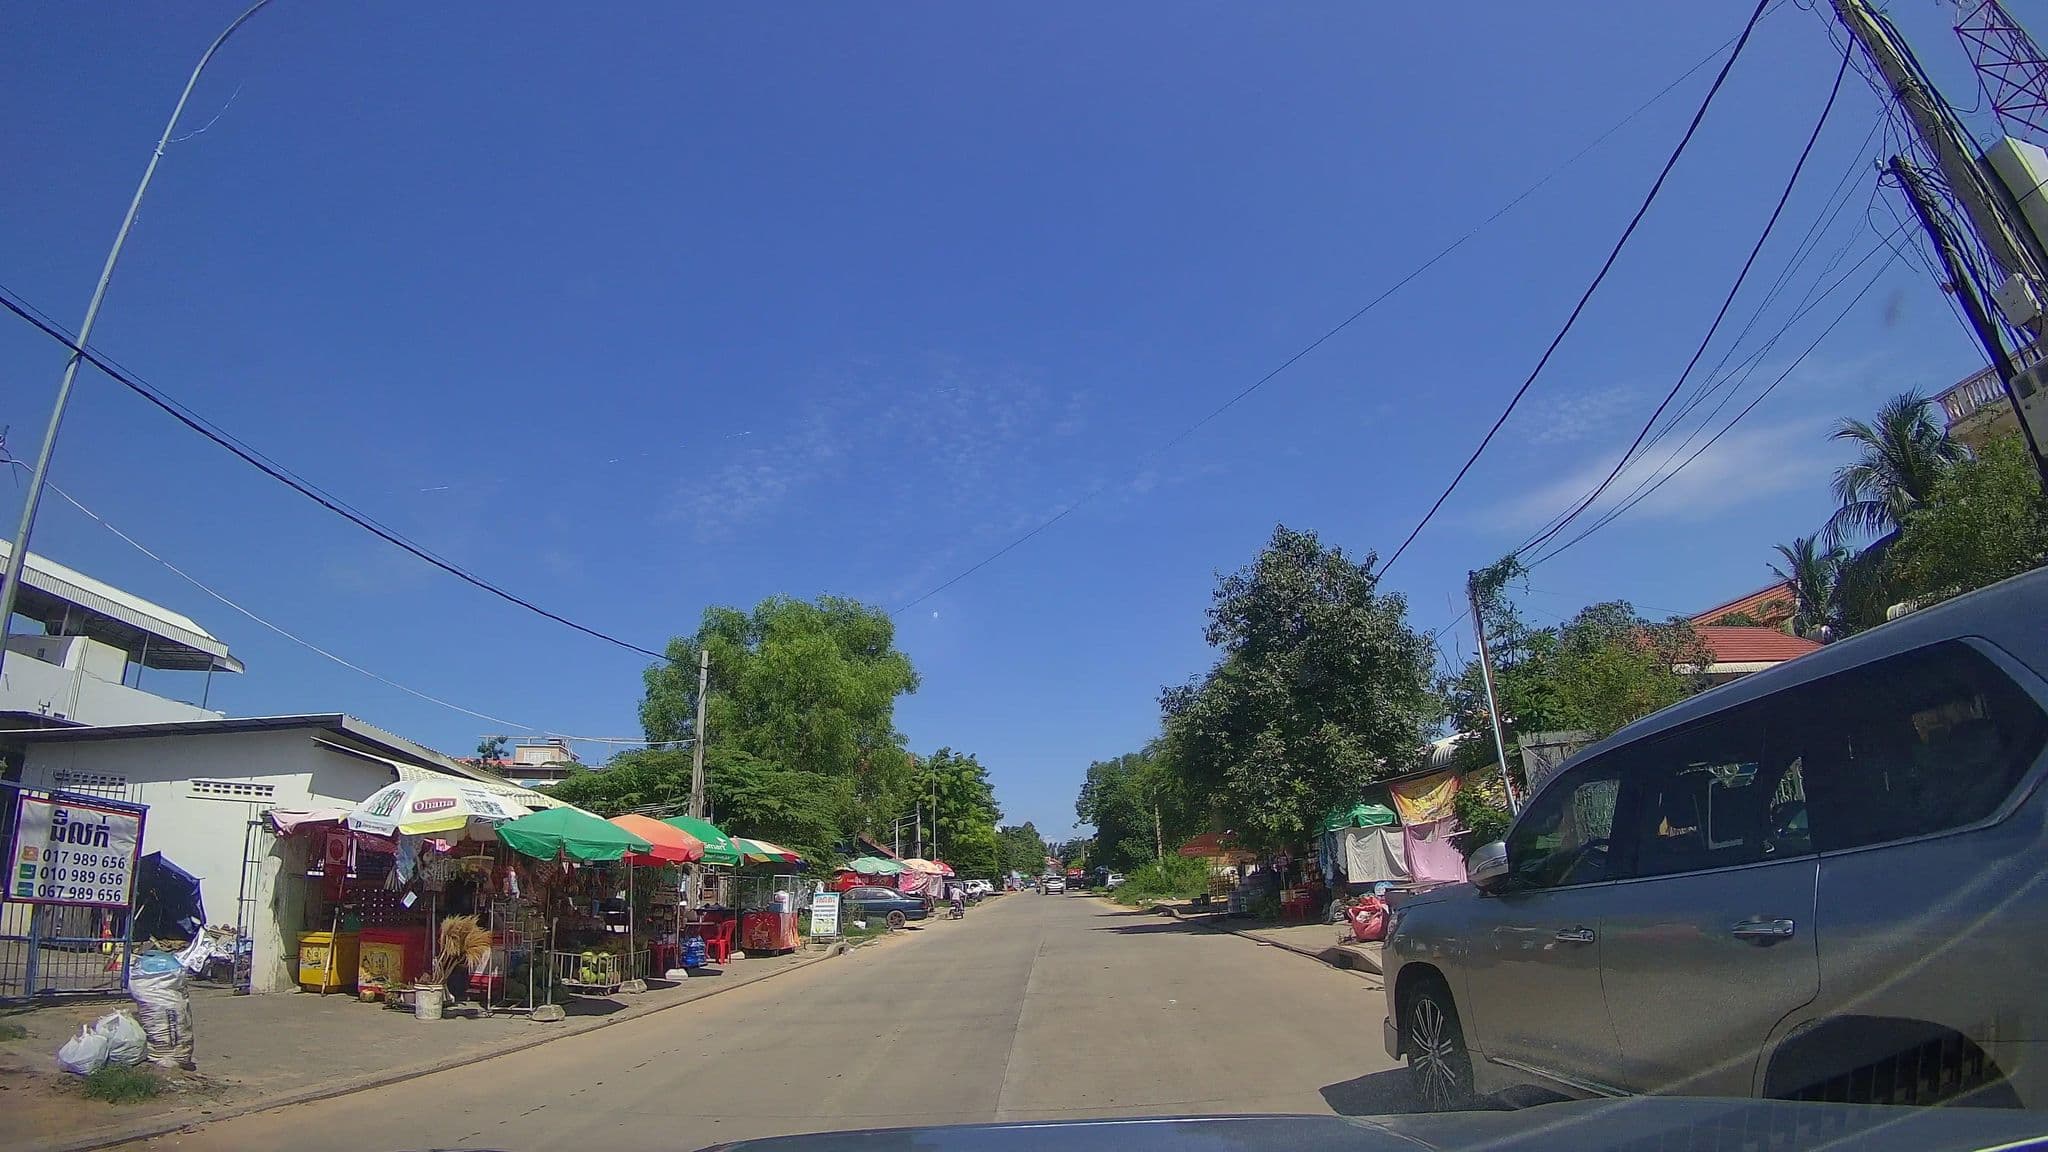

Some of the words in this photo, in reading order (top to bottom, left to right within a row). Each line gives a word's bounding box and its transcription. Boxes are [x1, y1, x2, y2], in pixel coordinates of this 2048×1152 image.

[414, 798, 454, 811] Ohana
[42, 849, 69, 864] 017
[73, 853, 97, 867] 989
[101, 856, 125, 870] 656
[40, 866, 67, 881] 010
[71, 869, 95, 883] 989
[99, 872, 123, 885] 656
[38, 884, 65, 898] 067
[69, 886, 93, 900] 989
[97, 888, 121, 902] 656
